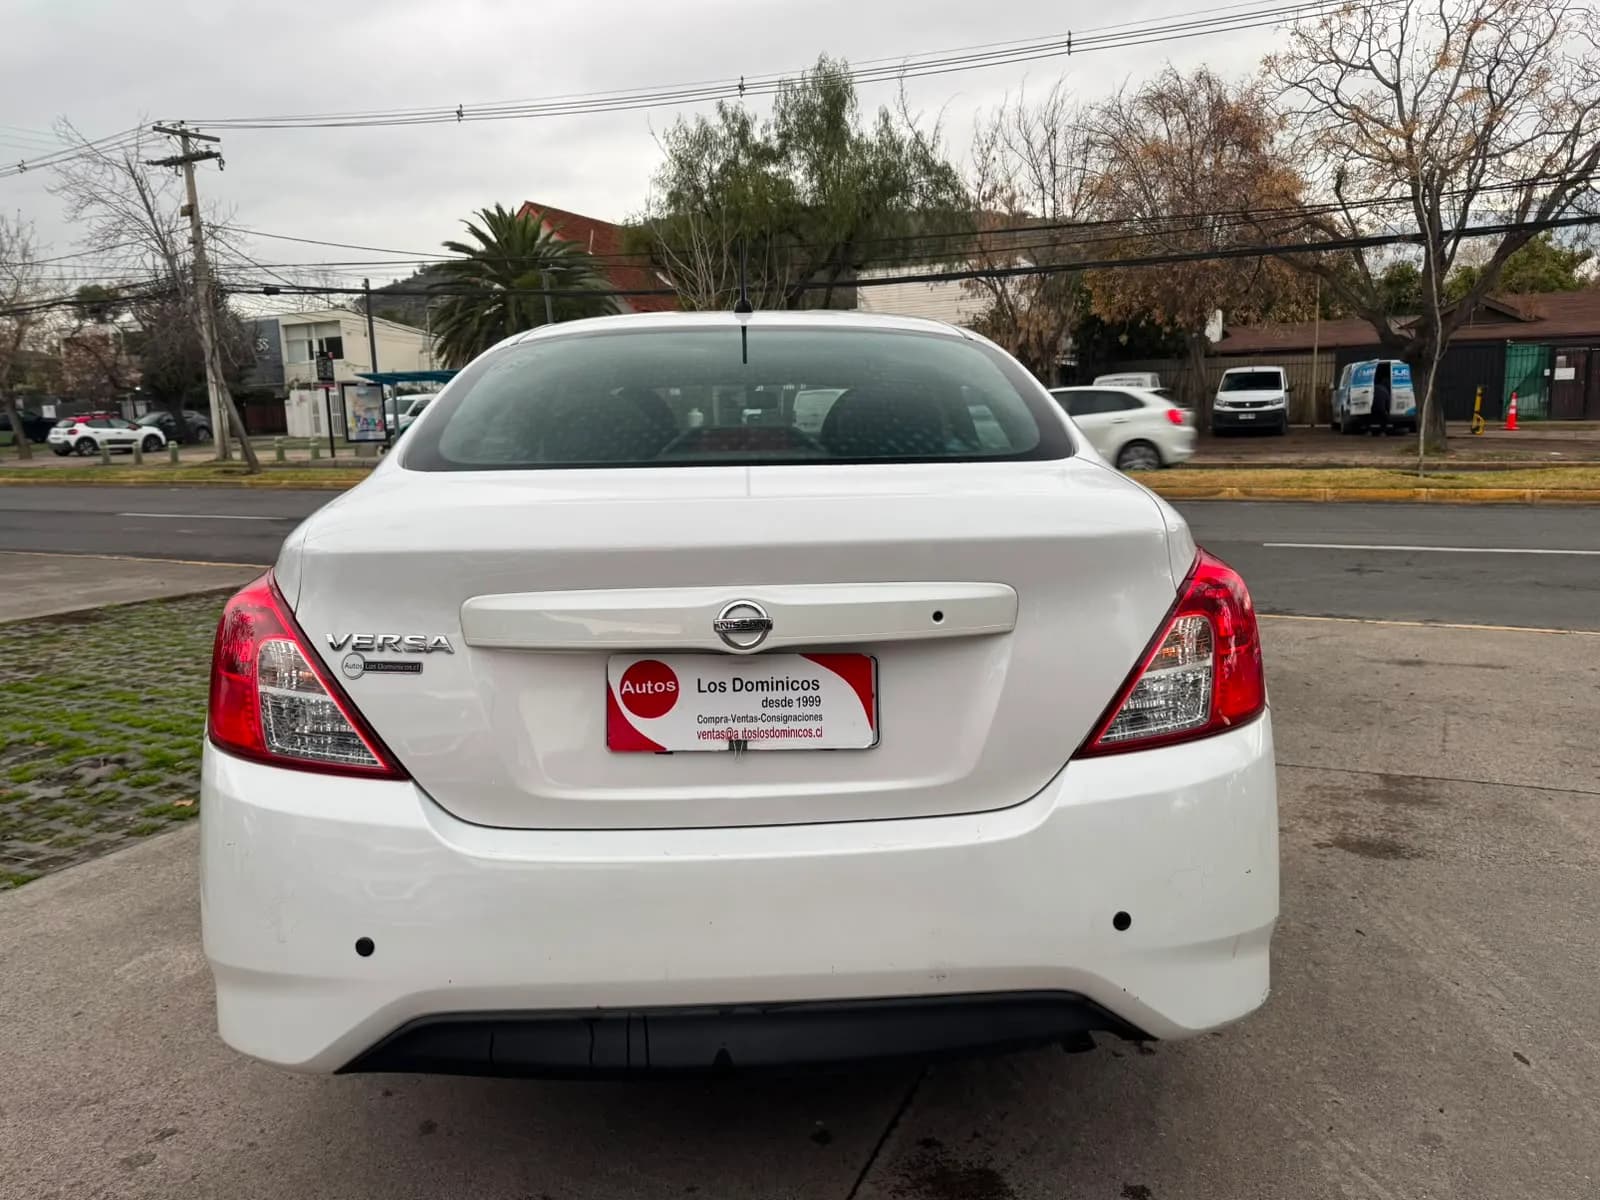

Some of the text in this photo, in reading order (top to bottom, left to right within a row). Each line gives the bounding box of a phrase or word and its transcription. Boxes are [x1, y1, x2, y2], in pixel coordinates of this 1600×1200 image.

[719, 620, 767, 631] NISSAN
[325, 633, 455, 654] VERSA
[344, 662, 363, 670] Autos
[621, 675, 820, 695] Autos Los Dominicos
[761, 695, 822, 709] desde 1999
[696, 712, 823, 726] Compra-Ventas-Consignaciones
